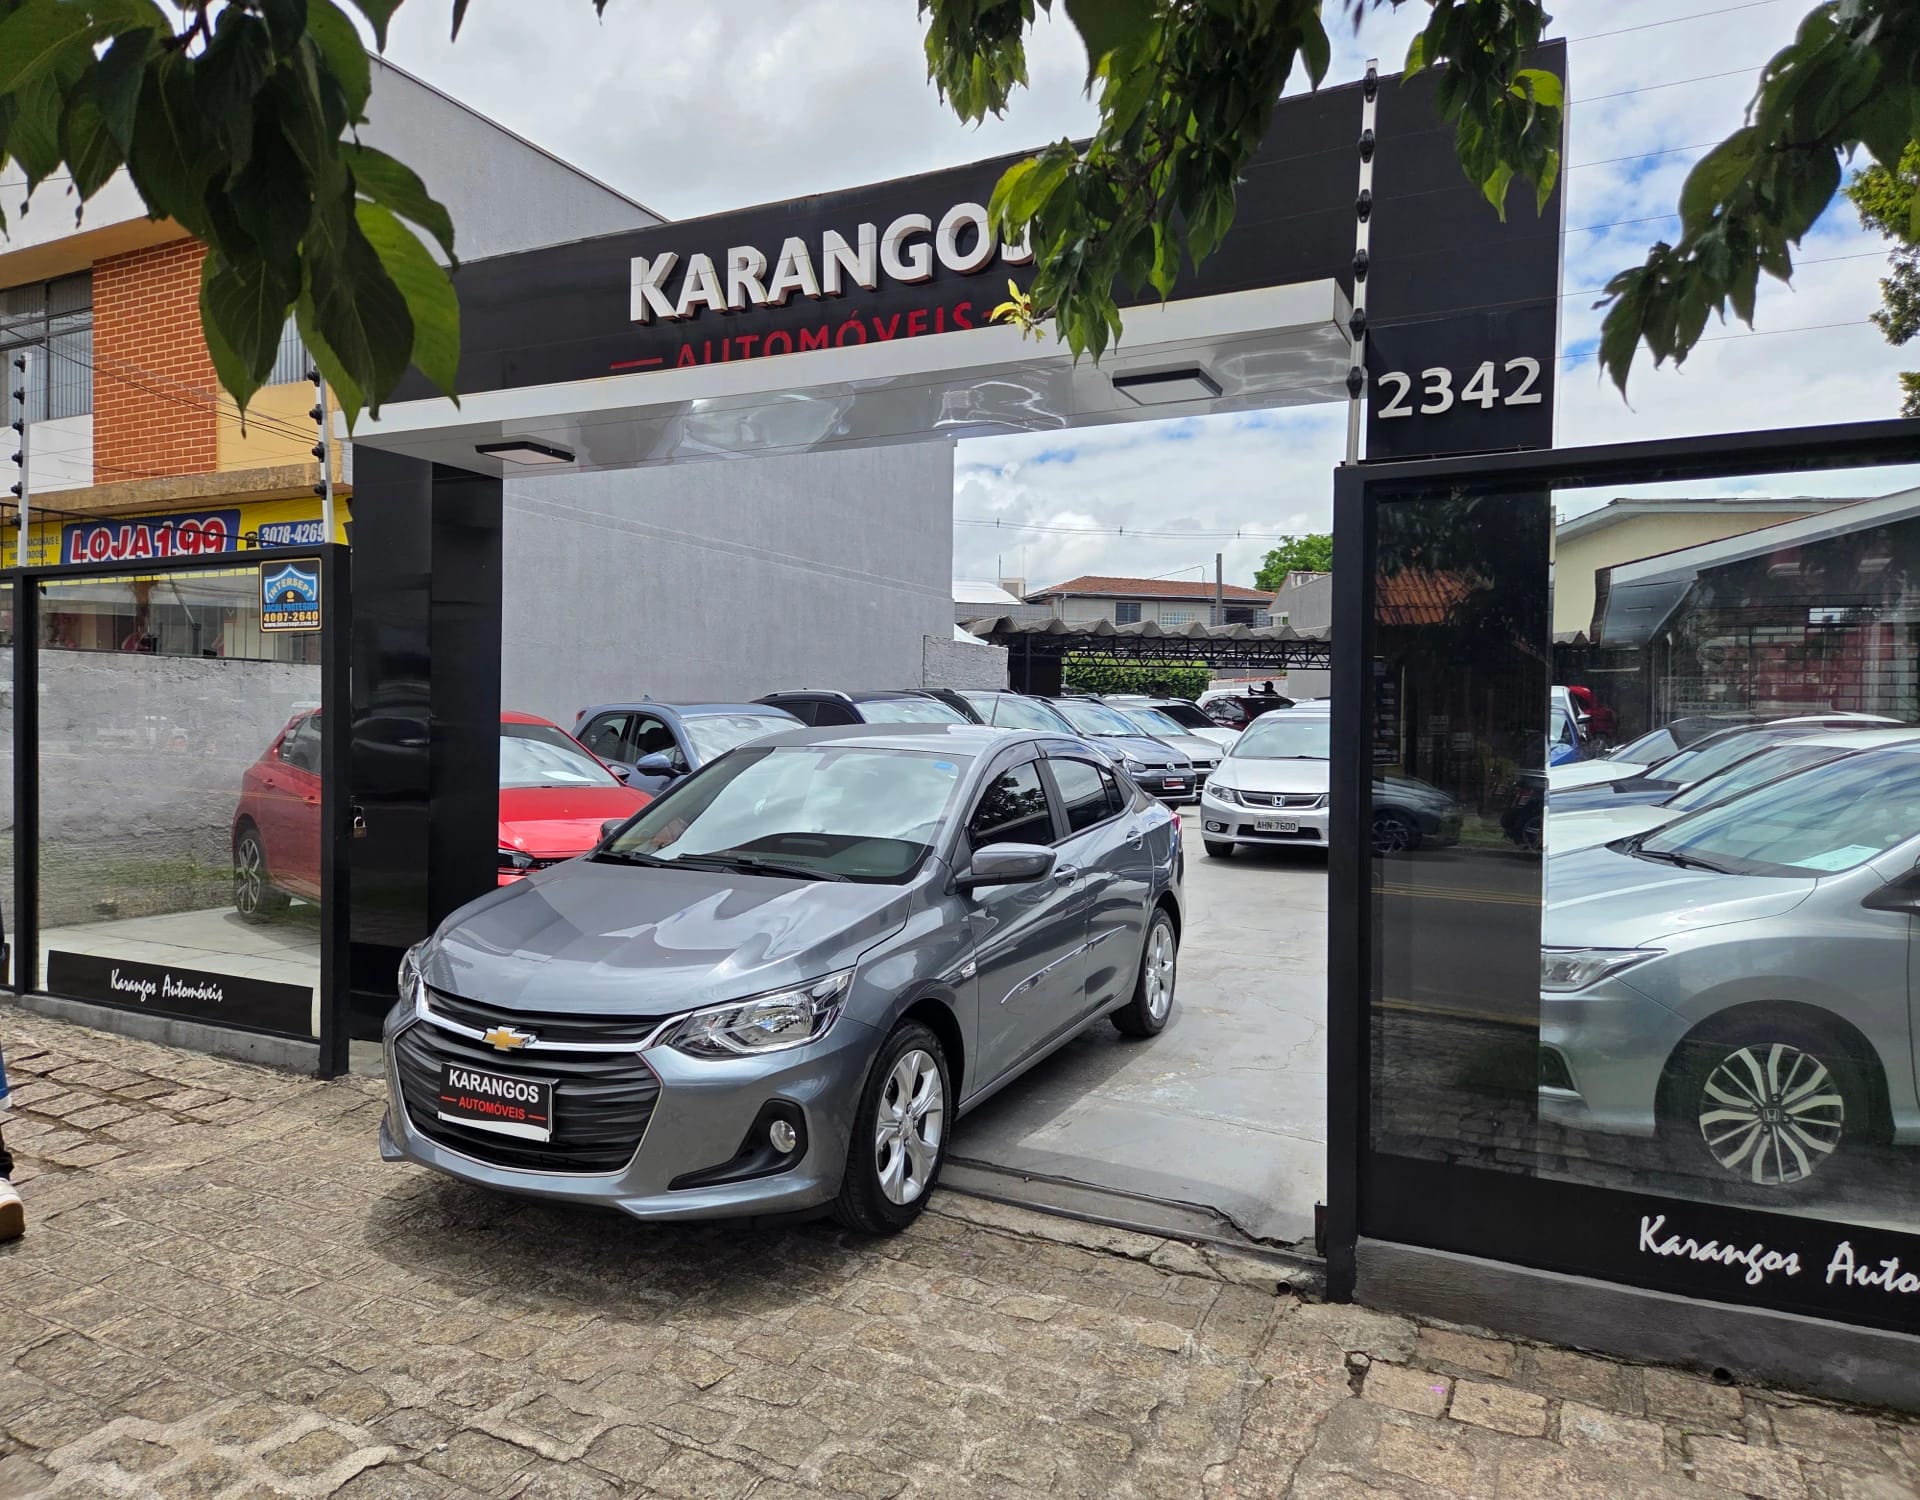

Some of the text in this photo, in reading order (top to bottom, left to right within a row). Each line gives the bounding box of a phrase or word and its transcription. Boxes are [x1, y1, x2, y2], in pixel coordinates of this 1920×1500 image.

[677, 301, 973, 368] AUTOMÓVEIS
[1378, 357, 1542, 418] 2342
[71, 525, 152, 563] LOJA
[262, 523, 325, 545] 3078-4269
[268, 577, 314, 599] INTERSEPT
[264, 602, 318, 612] LOCAL PROTEGIDO
[264, 611, 318, 622] 4007-2640
[110, 968, 224, 1002] Karangos Automóveis
[448, 1069, 539, 1104] KARANGOS
[458, 1096, 525, 1121] AUTOMÓVEIS
[1639, 1214, 1920, 1293] Karangos Auto
